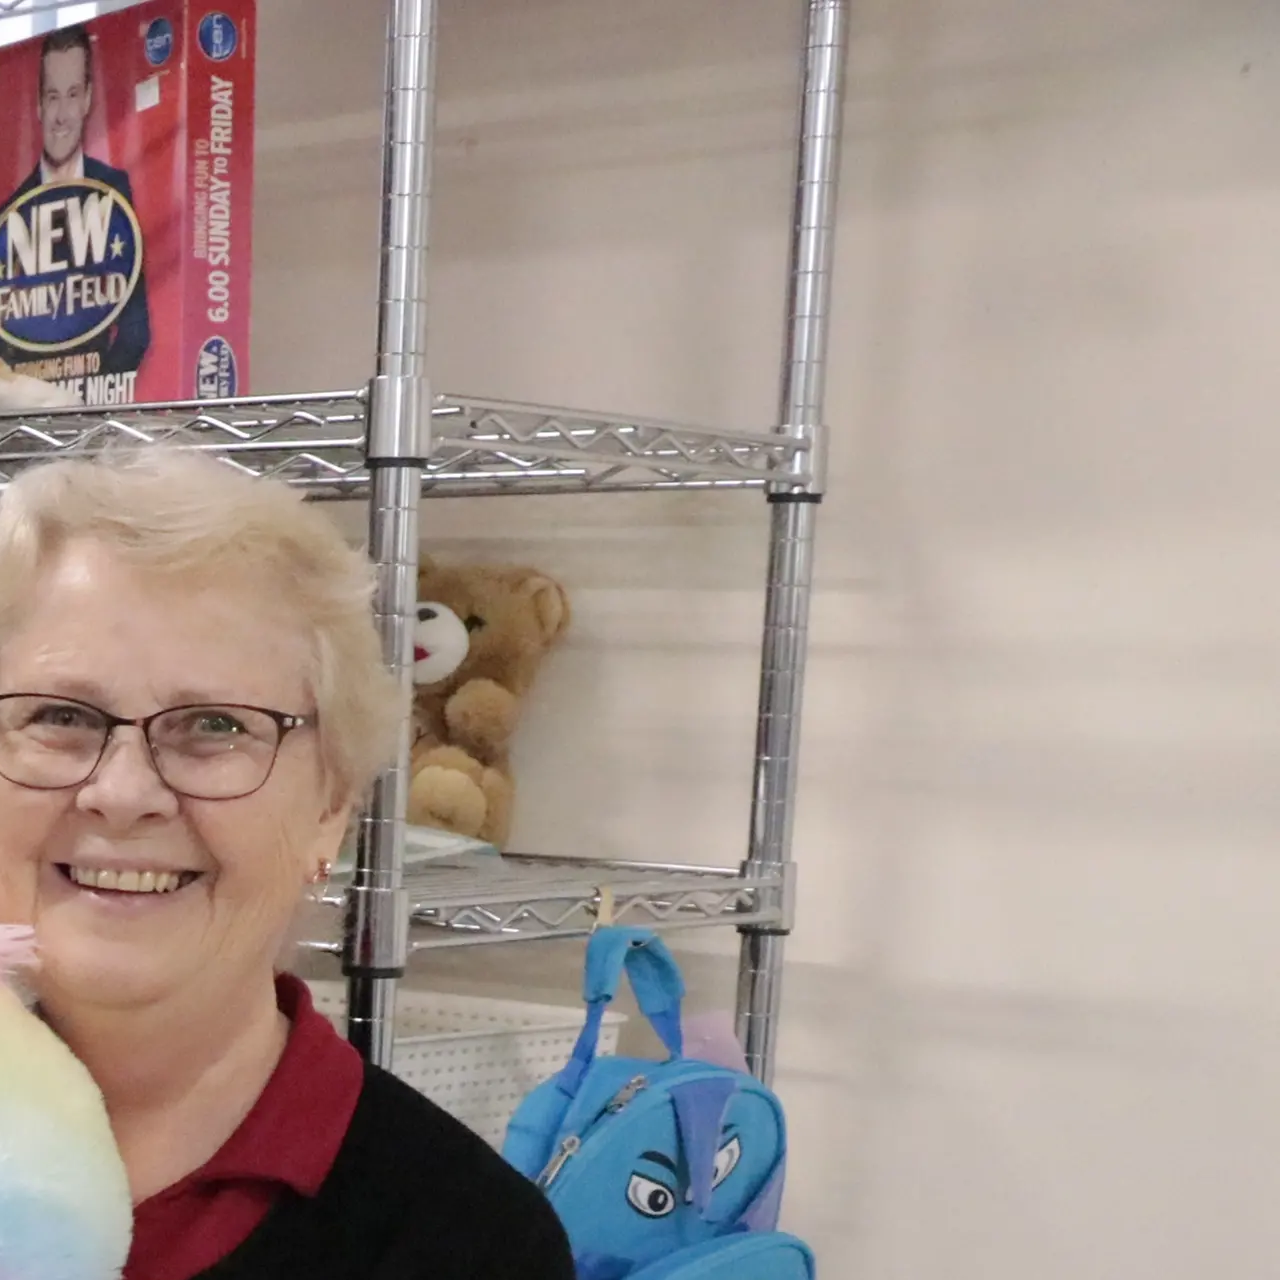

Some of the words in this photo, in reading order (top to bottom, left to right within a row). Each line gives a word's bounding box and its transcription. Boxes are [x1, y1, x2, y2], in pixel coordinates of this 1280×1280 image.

[210, 75, 234, 154] FRIDAY
[195, 138, 209, 155] TO
[212, 157, 228, 175] TO
[195, 156, 209, 189] FUN
[7, 188, 115, 280] NEW
[208, 176, 231, 266] SUNDAY
[65, 272, 128, 316] FEUD
[207, 270, 230, 323] 6.00
[86, 351, 100, 374] TO
[86, 370, 138, 405] NIGHT
